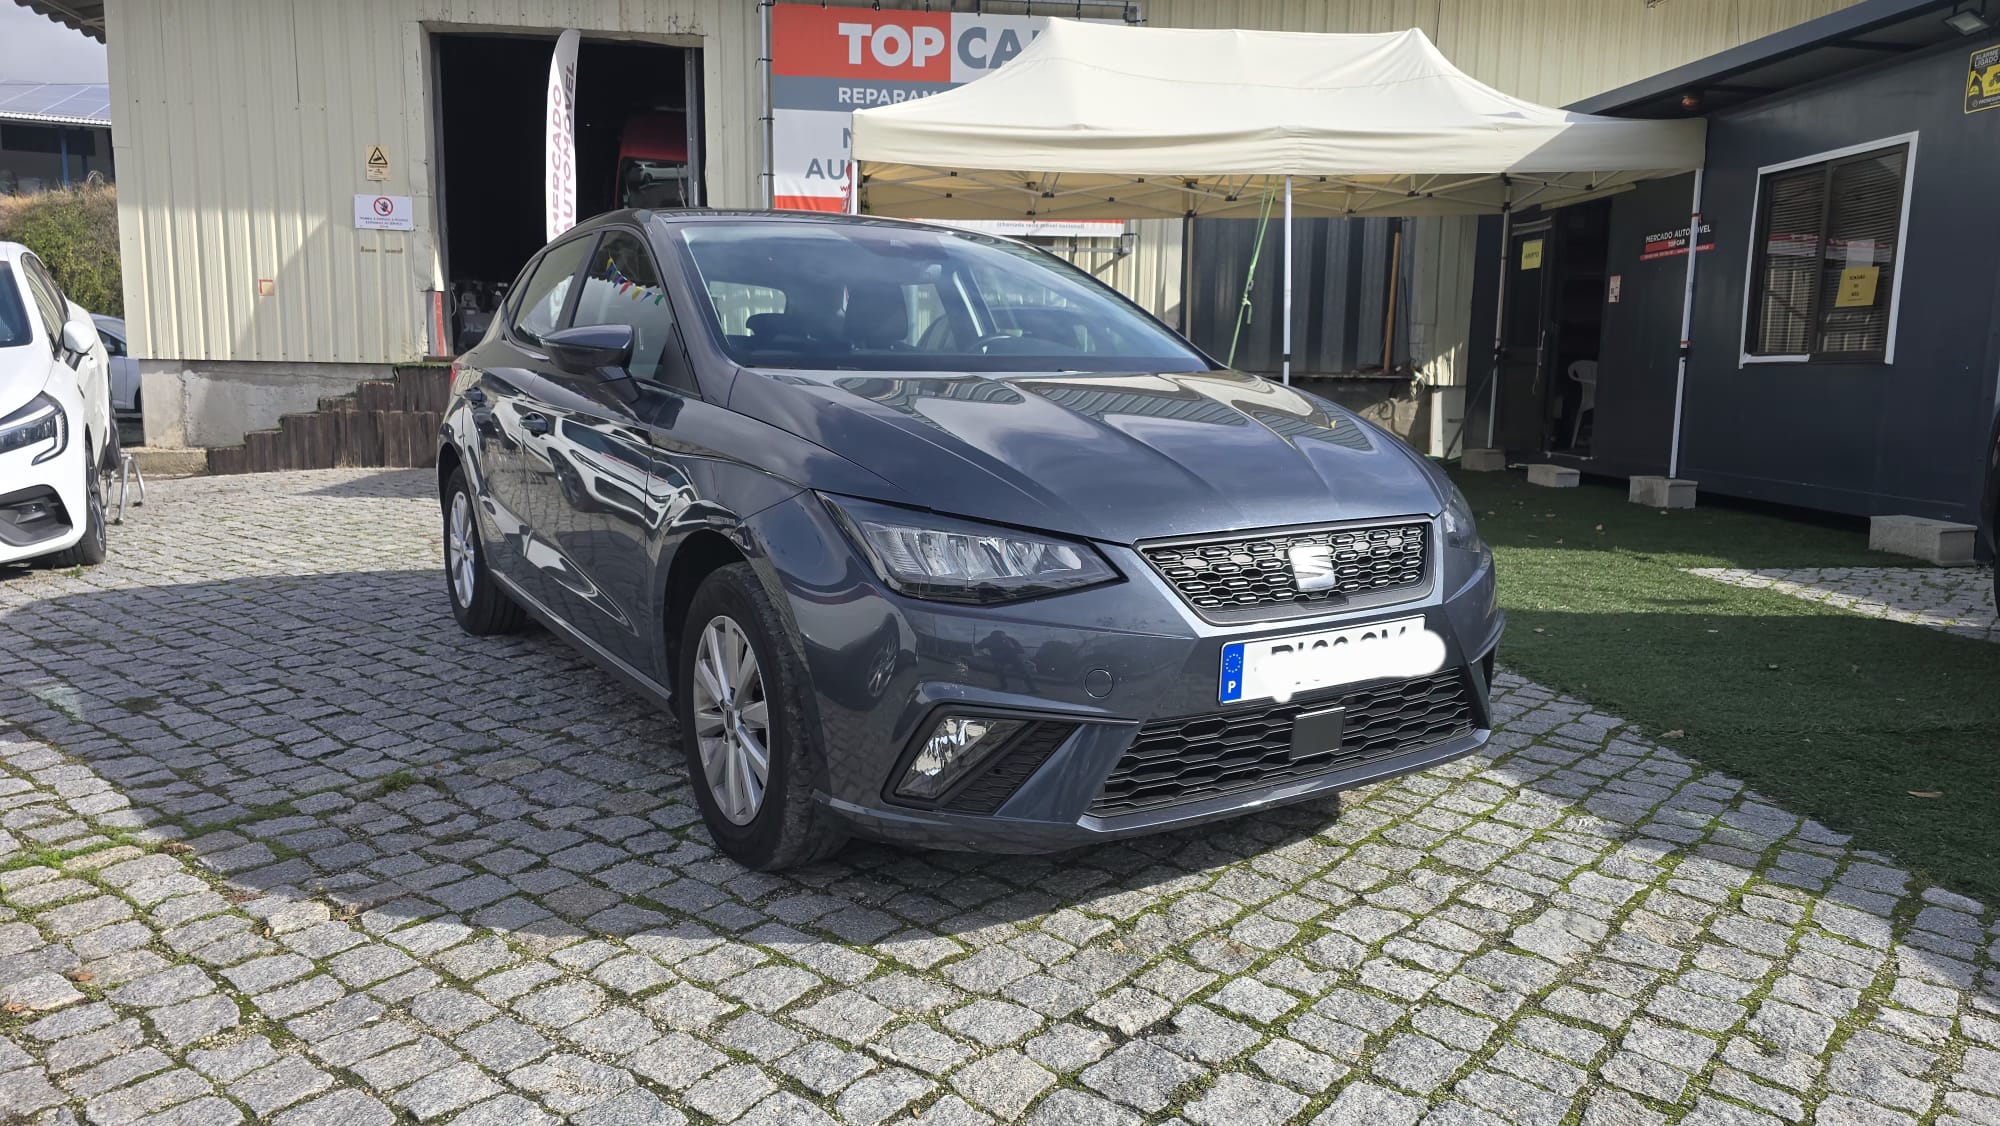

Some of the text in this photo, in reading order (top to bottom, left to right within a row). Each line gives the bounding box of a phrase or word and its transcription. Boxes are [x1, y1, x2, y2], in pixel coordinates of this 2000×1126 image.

[838, 22, 1040, 69] TOP CA
[552, 84, 563, 234] MERCADO
[805, 158, 845, 180] AU
[1645, 232, 1673, 243] MERCADO
[1227, 680, 1237, 694] P
